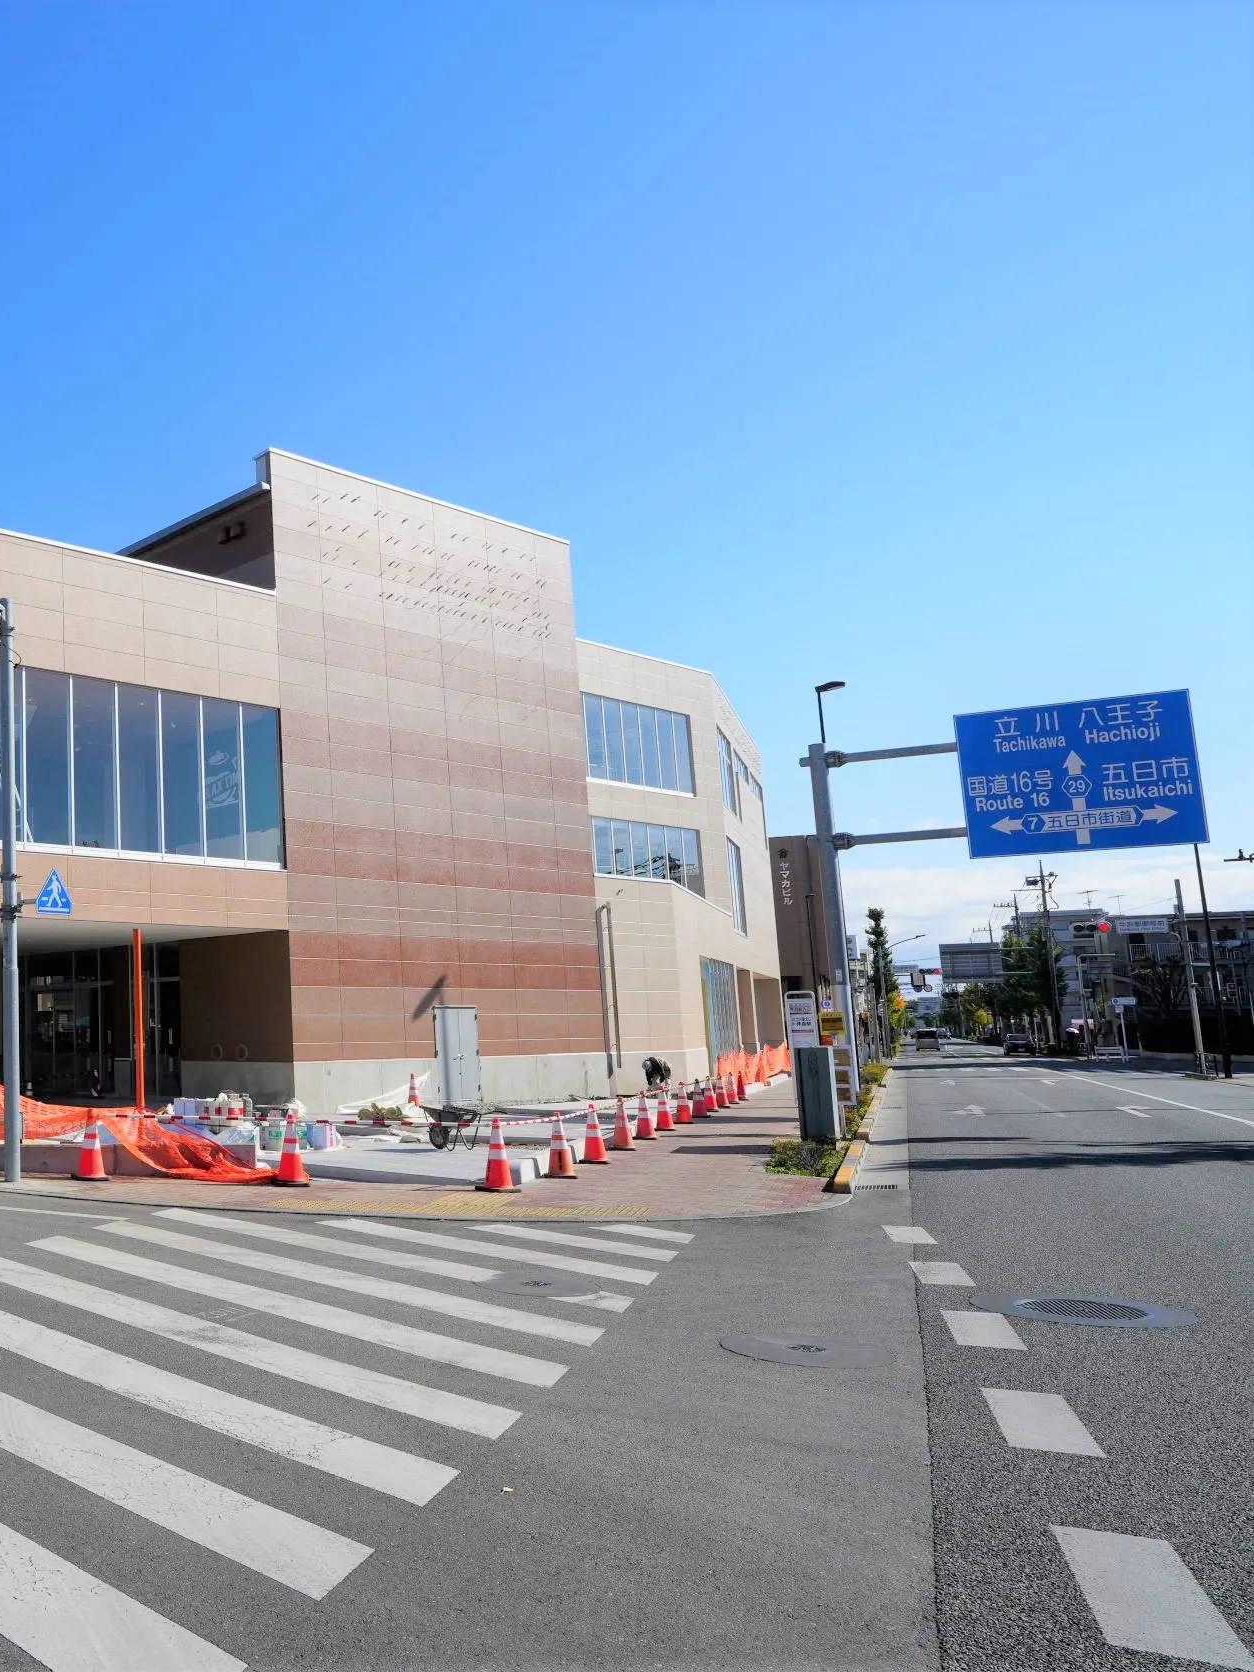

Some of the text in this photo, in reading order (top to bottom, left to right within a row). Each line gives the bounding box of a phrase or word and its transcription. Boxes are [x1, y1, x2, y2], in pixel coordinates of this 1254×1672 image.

[994, 700, 1162, 738] 立川 八王子
[993, 723, 1161, 753] Tachikawa Hachioji
[967, 770, 1054, 796] 国道16号
[1101, 757, 1190, 785] 五日市
[1067, 779, 1086, 793] 29
[1103, 780, 1193, 802] Itsukaichi
[975, 792, 1050, 812] Route 16
[1028, 817, 1038, 830] 7
[1047, 809, 1133, 829] 五日市街道
[779, 862, 794, 906] ヤマカビル
